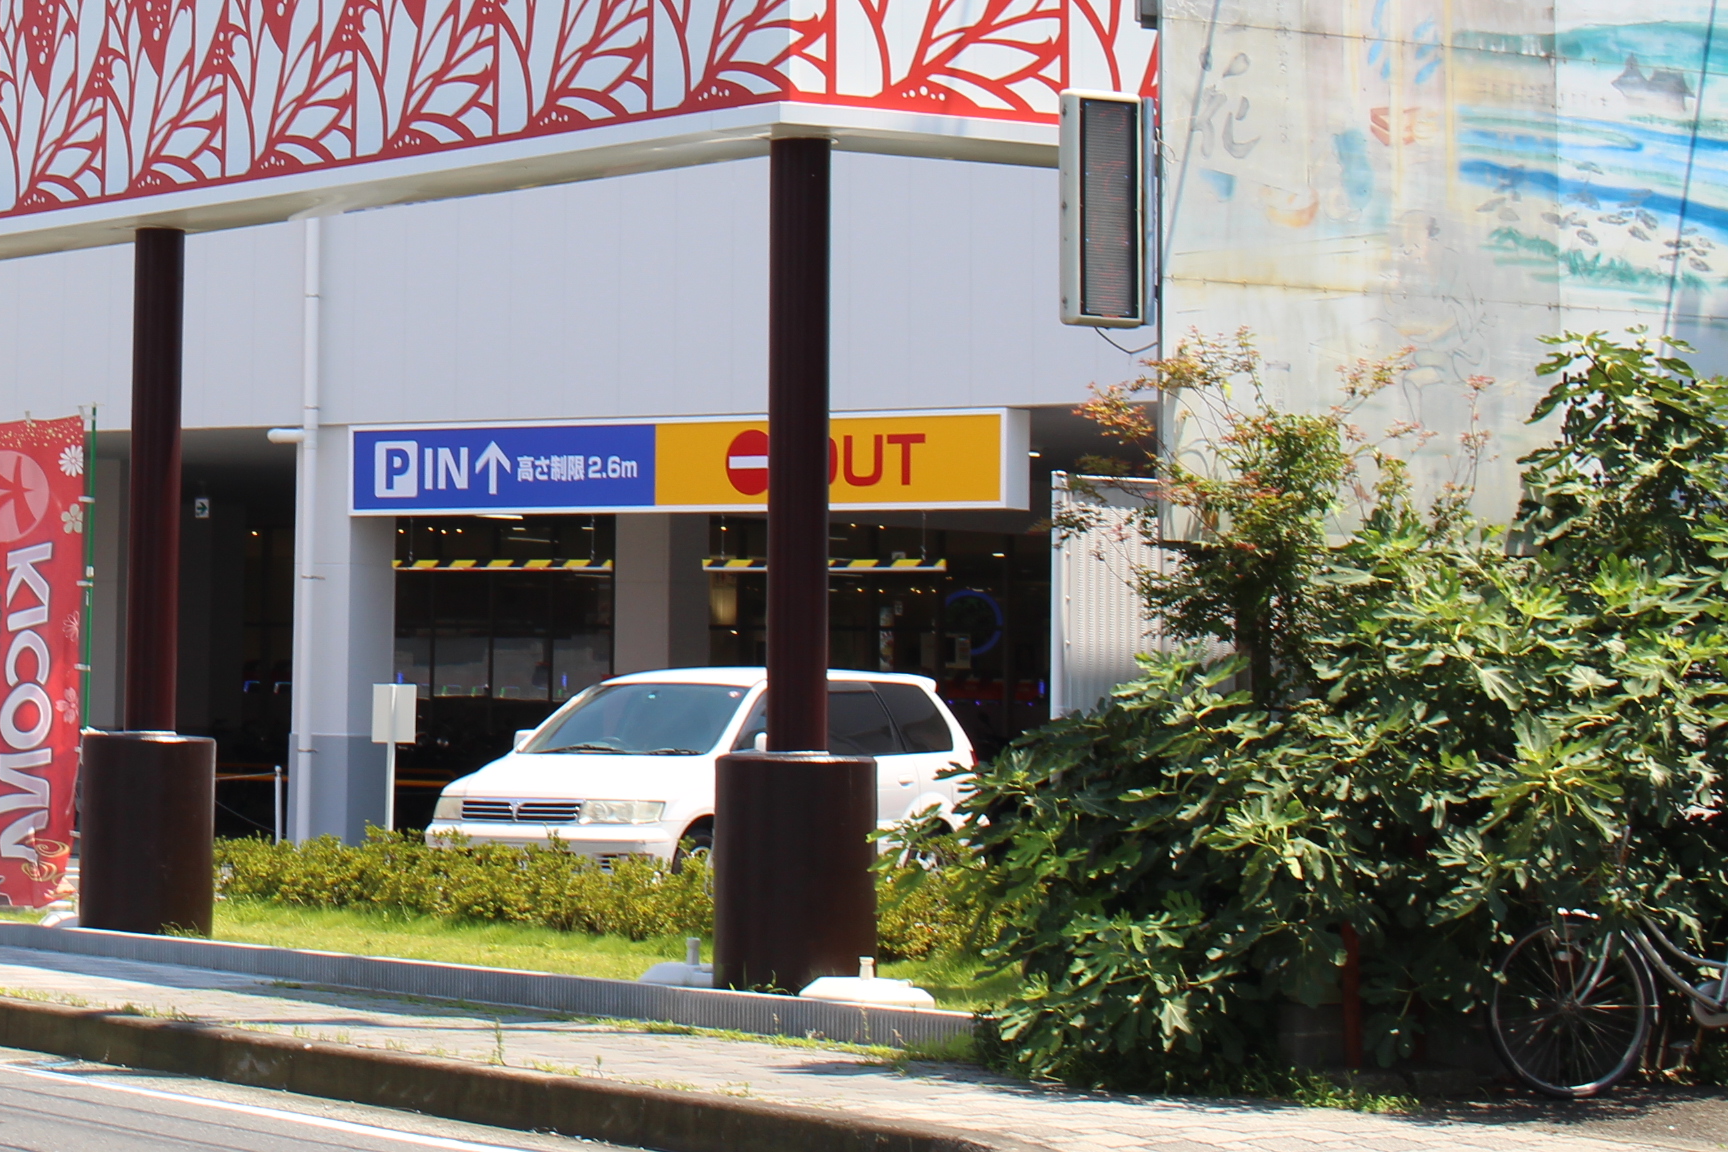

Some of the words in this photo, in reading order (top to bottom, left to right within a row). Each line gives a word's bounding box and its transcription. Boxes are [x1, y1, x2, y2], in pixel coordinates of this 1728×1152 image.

[385, 448, 410, 491] P
[424, 447, 469, 490] IN
[829, 433, 926, 487] UT
